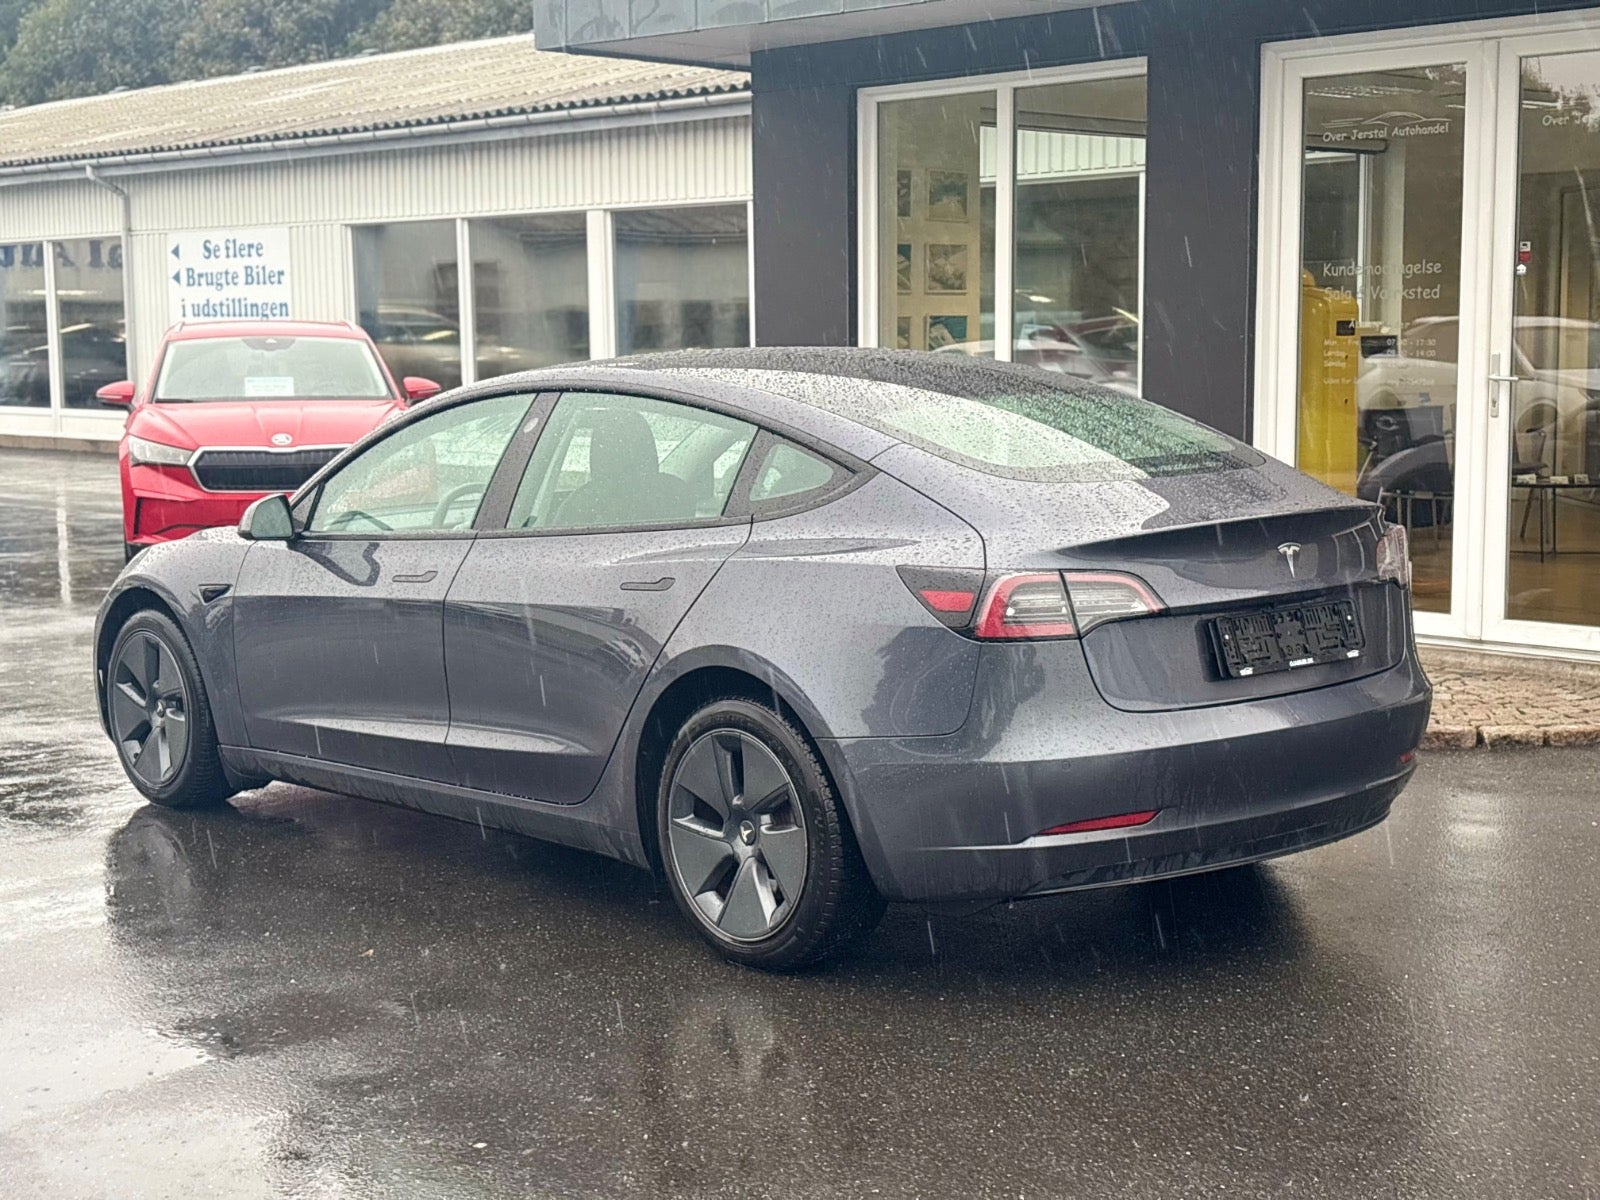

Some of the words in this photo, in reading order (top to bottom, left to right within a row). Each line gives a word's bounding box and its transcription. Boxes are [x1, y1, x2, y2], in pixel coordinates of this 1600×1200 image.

[1322, 132, 1347, 142] Over
[1350, 127, 1388, 141] Jerstal
[1391, 122, 1449, 137] Autohandel
[202, 239, 221, 259] Se
[224, 238, 264, 258] flere
[185, 267, 239, 292] Brugte
[243, 265, 285, 285] Biler
[180, 298, 187, 318] i
[191, 297, 290, 320] udstillingen
